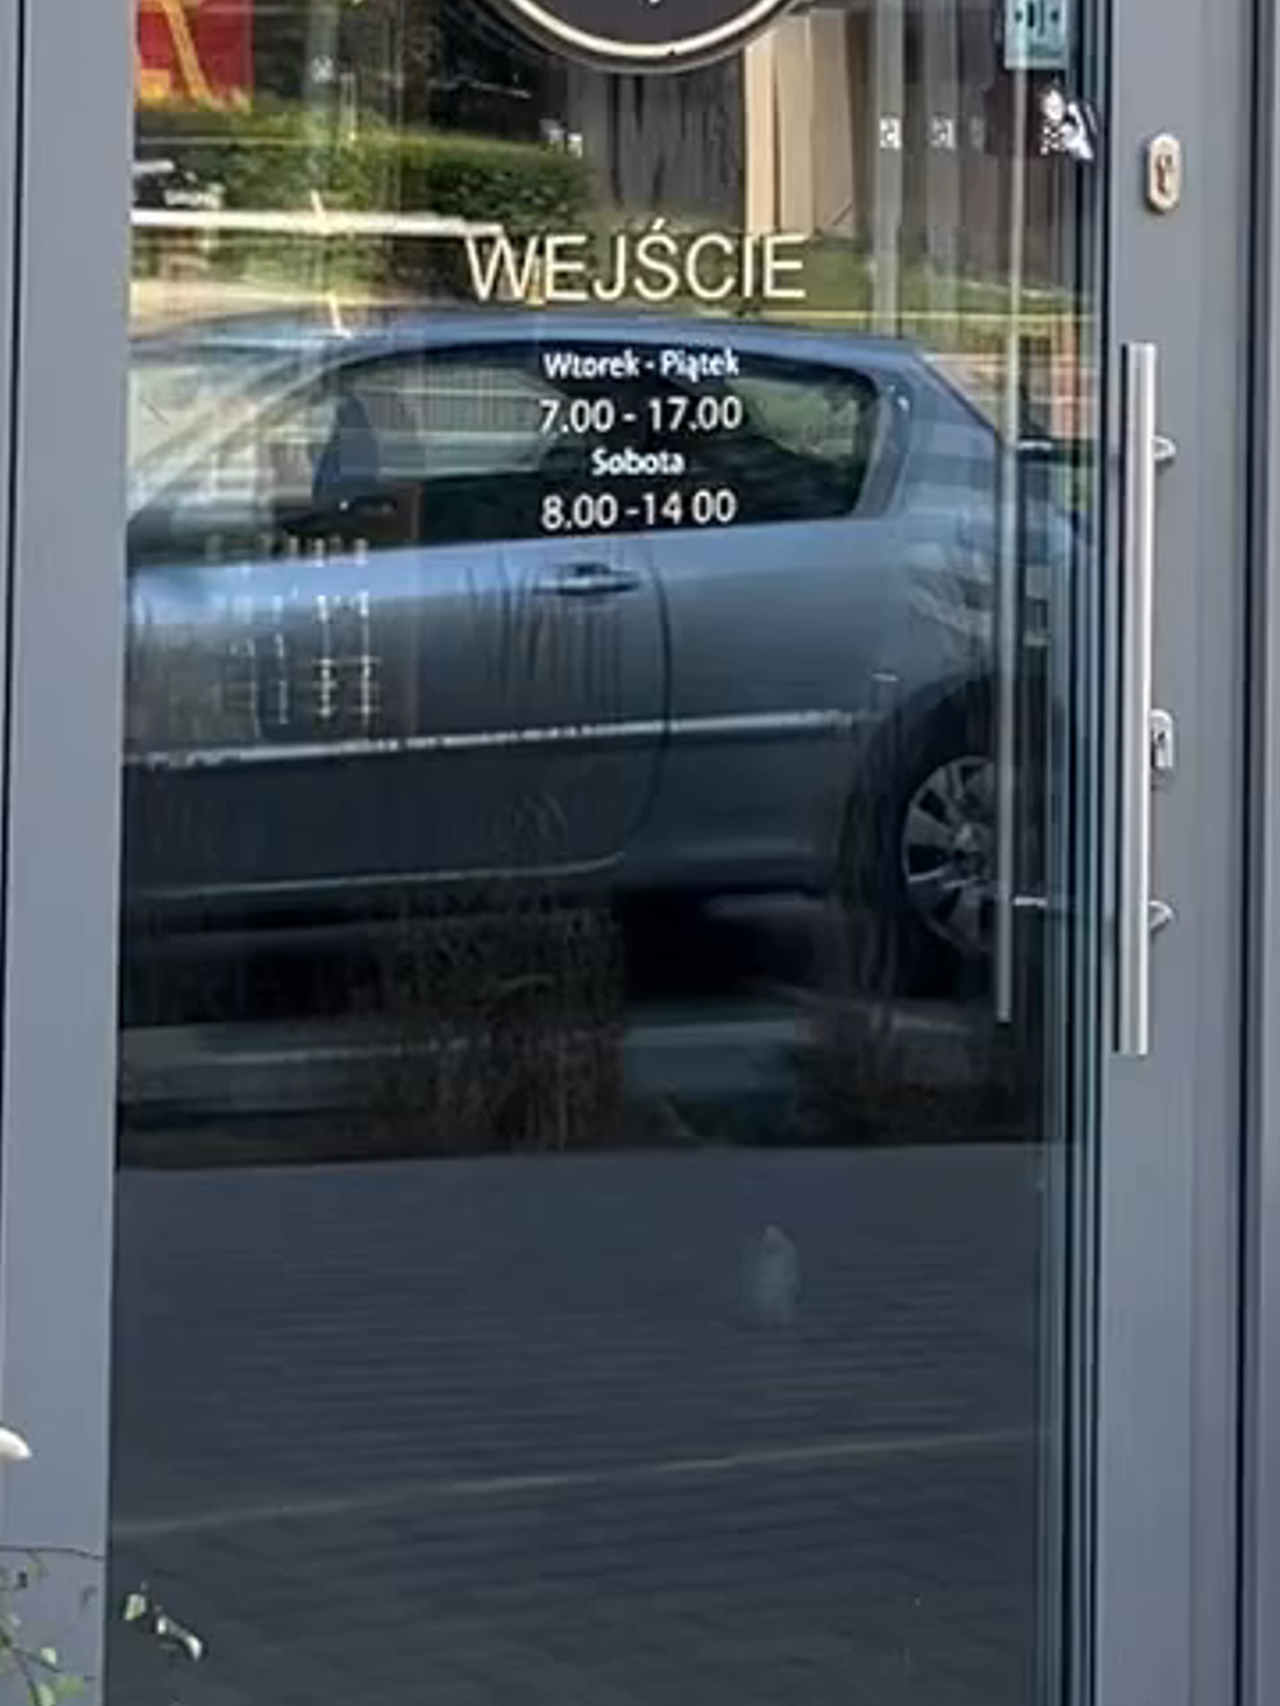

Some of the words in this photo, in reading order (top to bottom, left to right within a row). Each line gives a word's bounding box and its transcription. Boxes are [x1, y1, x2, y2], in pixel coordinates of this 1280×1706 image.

[465, 217, 807, 302] WEJŚCIE
[542, 348, 640, 379] Wtorek
[659, 346, 740, 384] Piątek
[539, 397, 615, 434] 7.00
[648, 394, 744, 432] 17.00
[590, 445, 687, 477] Sobota
[540, 491, 619, 530] 8.00
